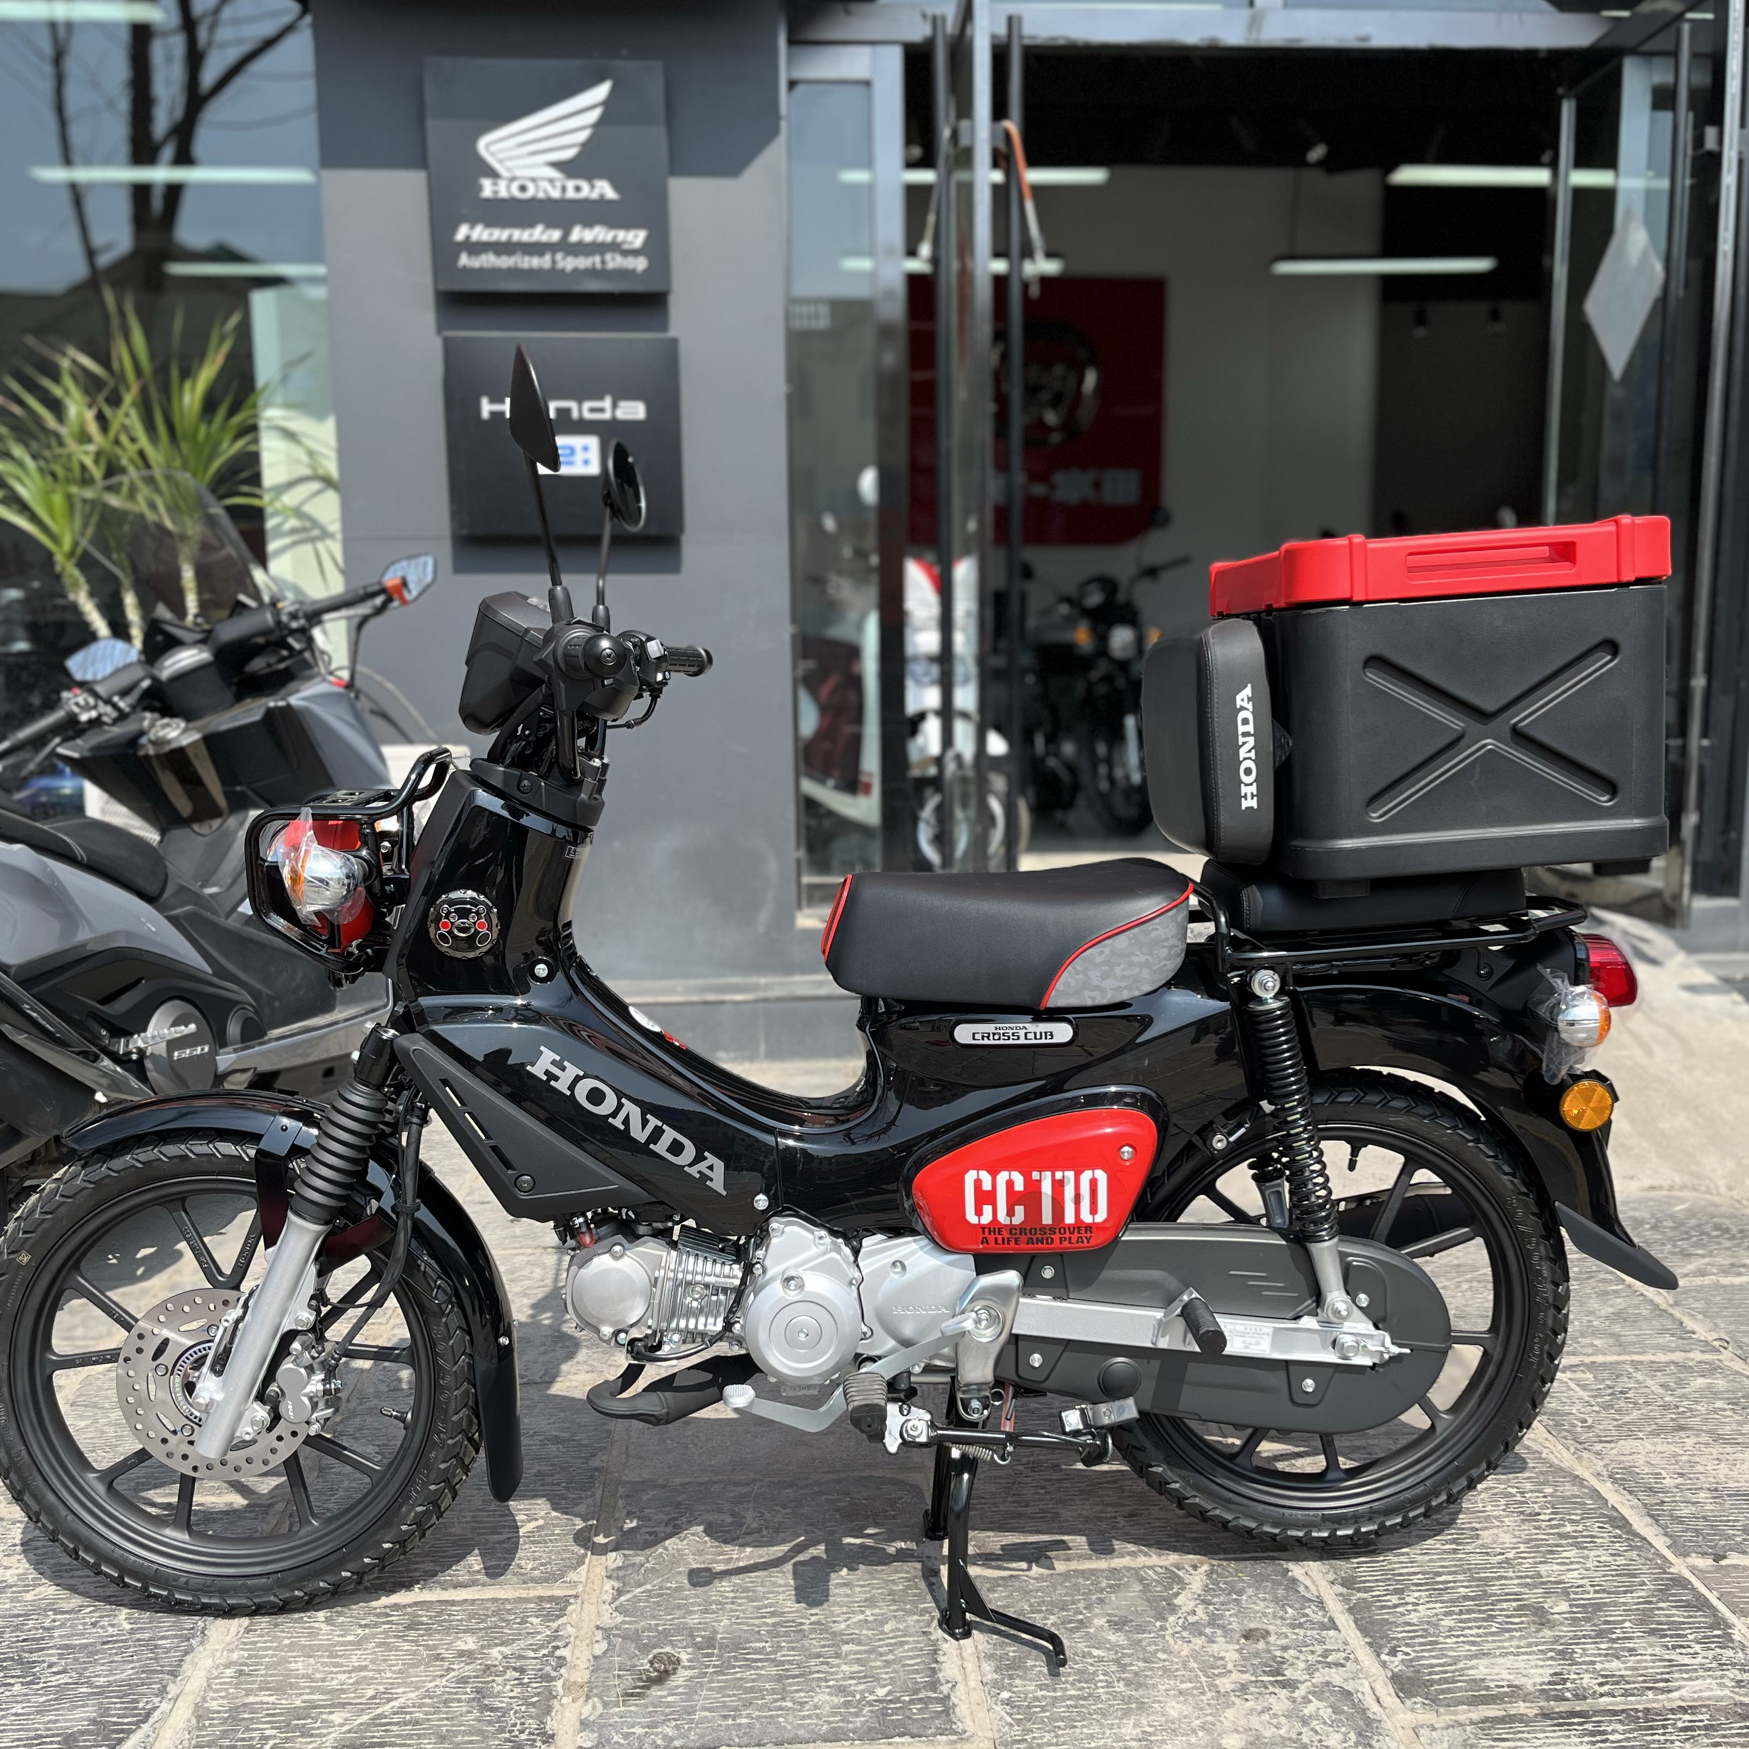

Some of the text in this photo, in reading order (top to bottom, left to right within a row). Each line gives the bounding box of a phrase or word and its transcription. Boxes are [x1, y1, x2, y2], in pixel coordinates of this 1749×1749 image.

[479, 177, 620, 200] HONDA
[454, 223, 649, 250] Honda Wing
[457, 251, 649, 274] Authorized Sport Shop
[480, 394, 647, 421] Hnda
[1235, 683, 1258, 810] HONDA
[972, 1031, 1054, 1041] CROSS CUB
[525, 1045, 728, 1197] HONDA
[980, 1226, 1093, 1236] THE CROSSOVER
[980, 1235, 1092, 1246] A LIFE AND PLAY
[892, 1305, 950, 1315] HONDA
